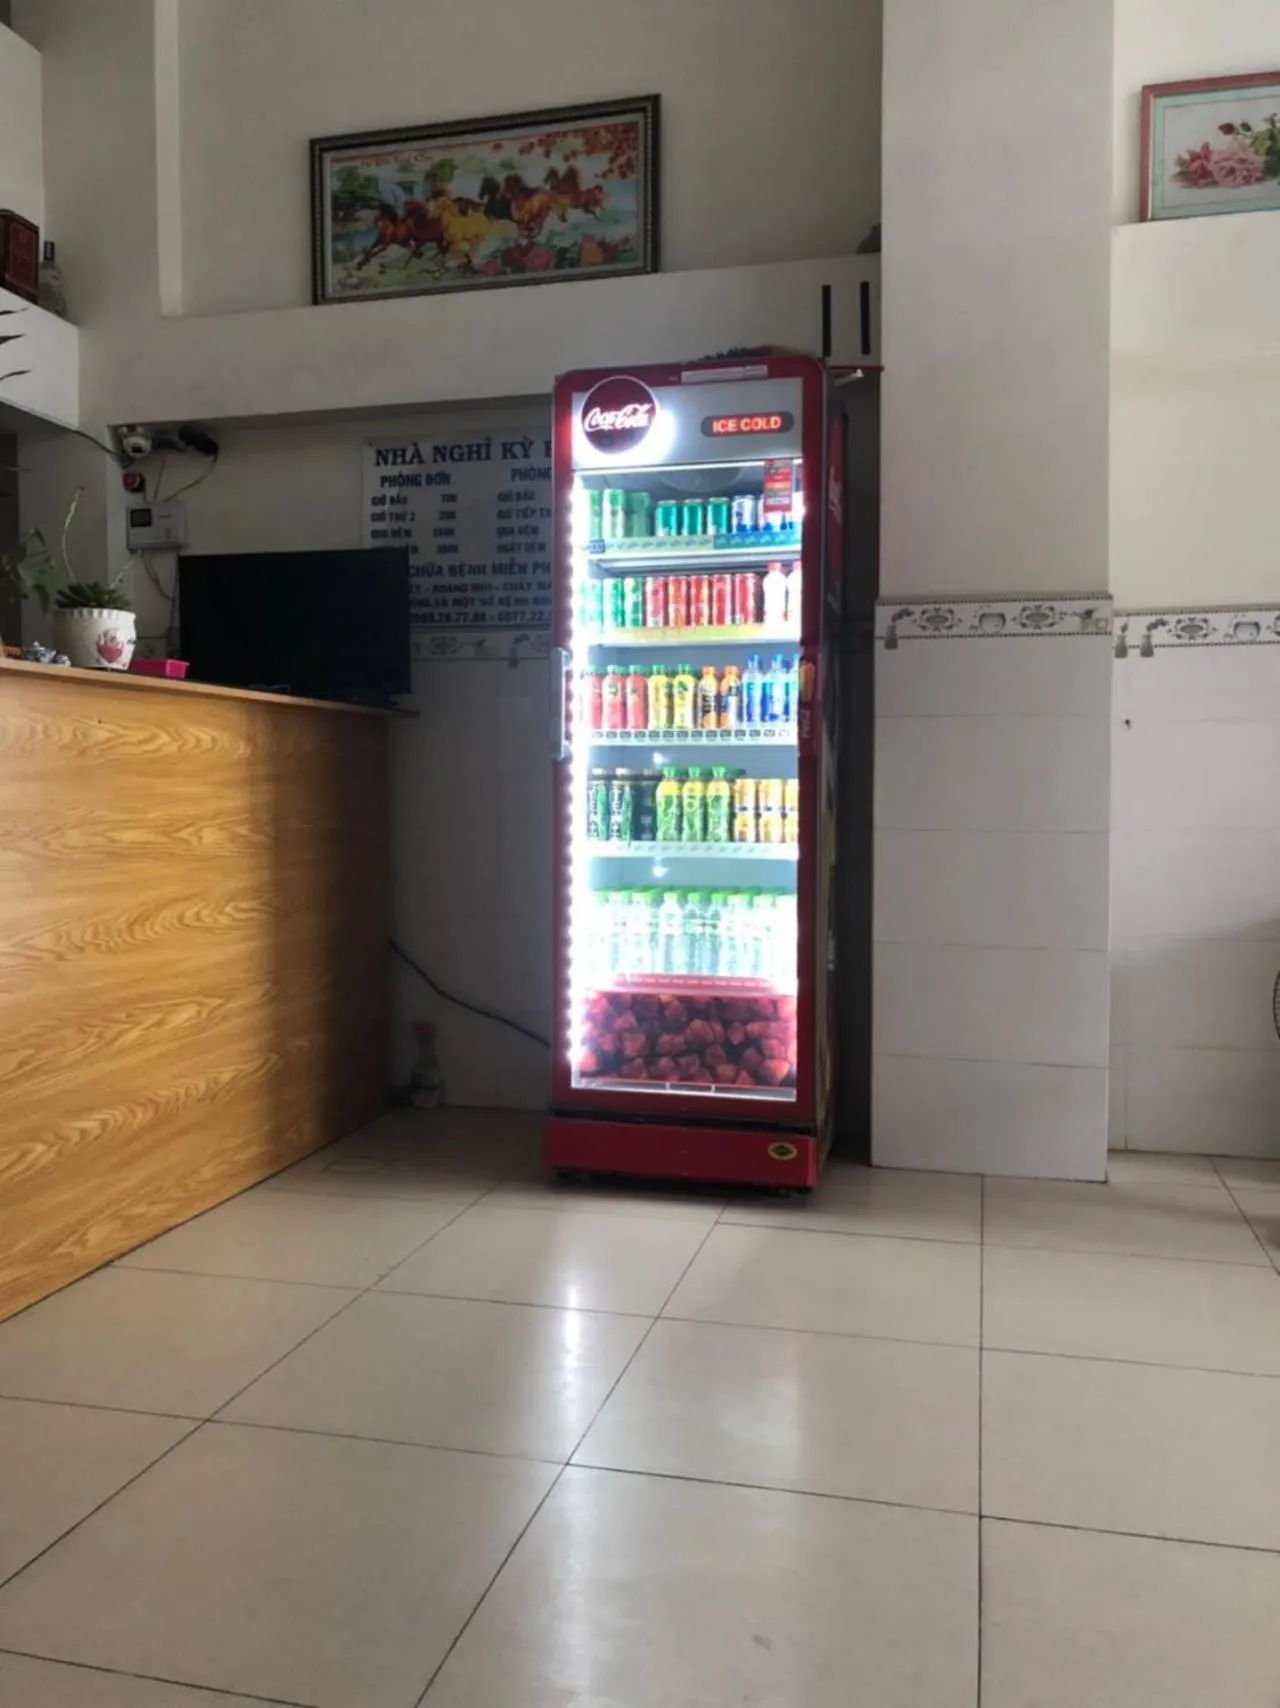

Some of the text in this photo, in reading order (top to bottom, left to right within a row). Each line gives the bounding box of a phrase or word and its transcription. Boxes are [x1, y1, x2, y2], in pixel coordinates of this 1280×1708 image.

[712, 414, 781, 433] ICE COLD
[375, 442, 425, 467] NHÀ
[433, 435, 492, 464] NGHỈ
[501, 434, 535, 461] KỲ
[381, 471, 422, 488] PHÒNG
